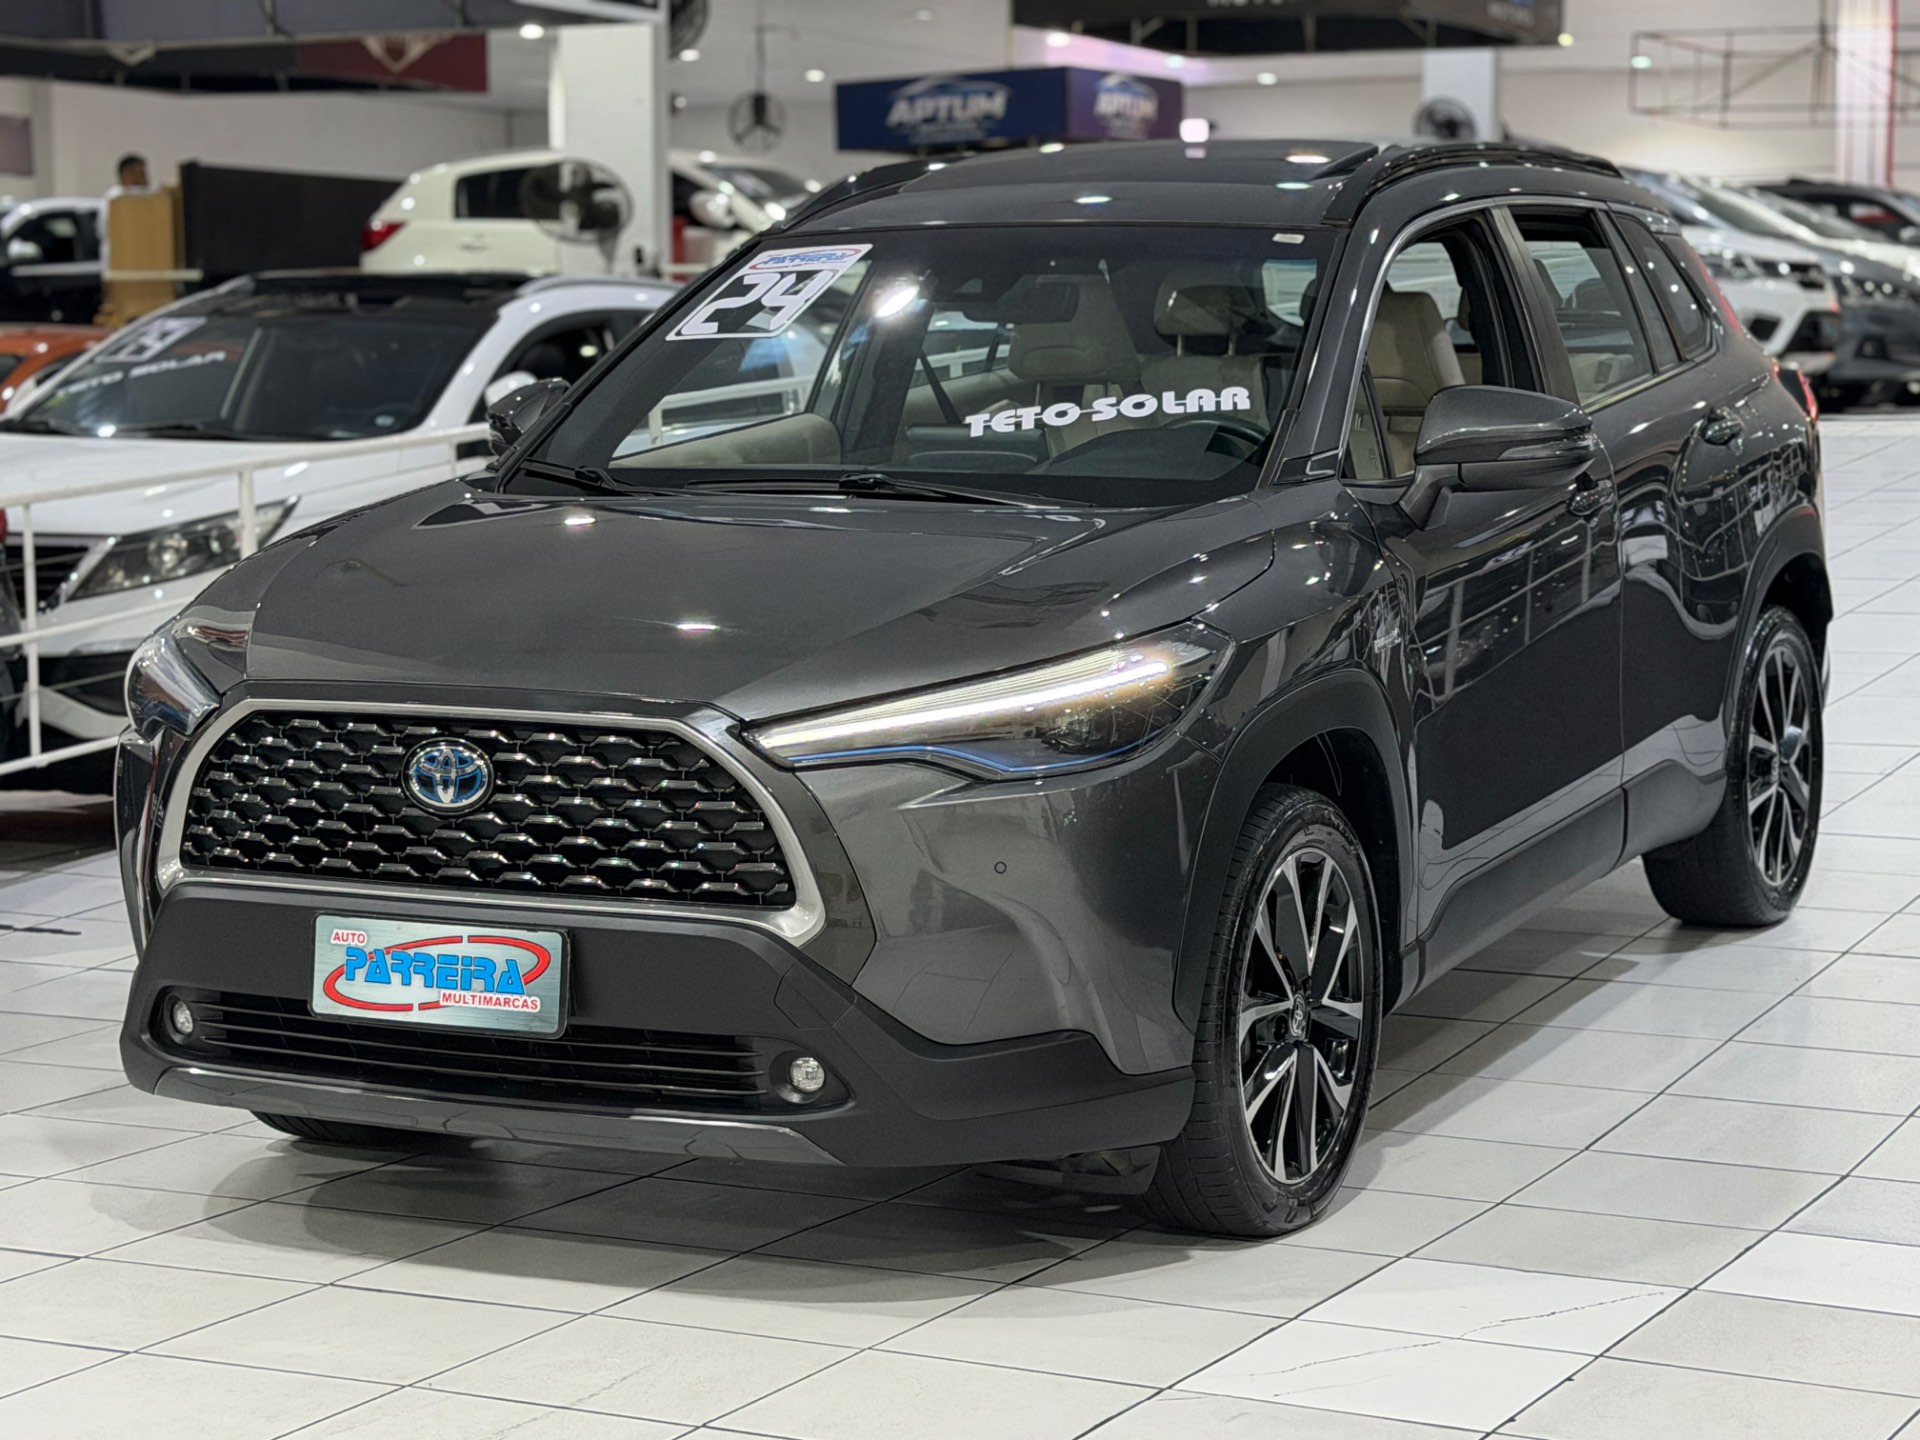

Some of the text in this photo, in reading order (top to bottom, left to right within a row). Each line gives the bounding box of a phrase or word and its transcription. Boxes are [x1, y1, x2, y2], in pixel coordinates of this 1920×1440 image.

[680, 270, 834, 335] 24
[965, 386, 1251, 438] TETO SOLAR
[332, 930, 366, 944] AUTO
[345, 946, 525, 995] PARREIRA
[441, 992, 539, 1011] MULTIMARCAS
